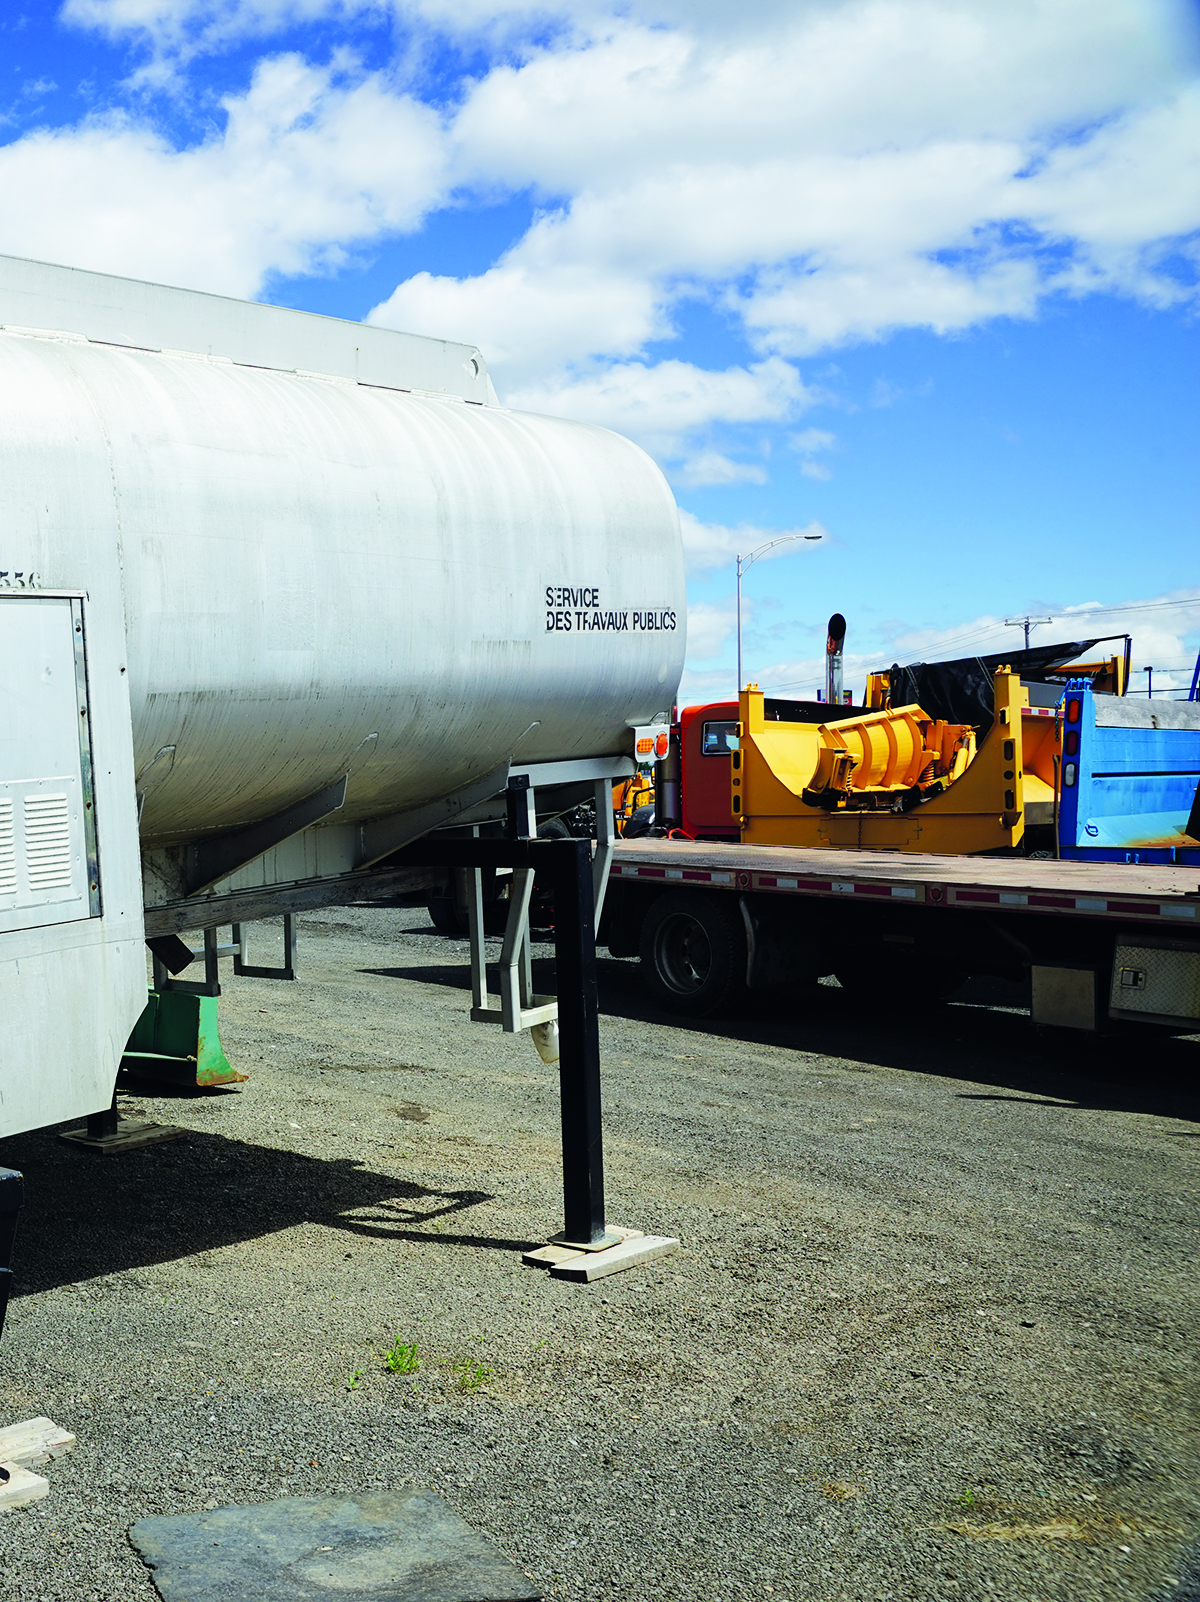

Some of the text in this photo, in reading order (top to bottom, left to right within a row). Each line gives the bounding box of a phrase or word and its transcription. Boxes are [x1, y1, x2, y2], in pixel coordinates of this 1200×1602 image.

[545, 586, 600, 608] SERVICE
[546, 610, 677, 631] DES TRAVAUX PUBLICS
